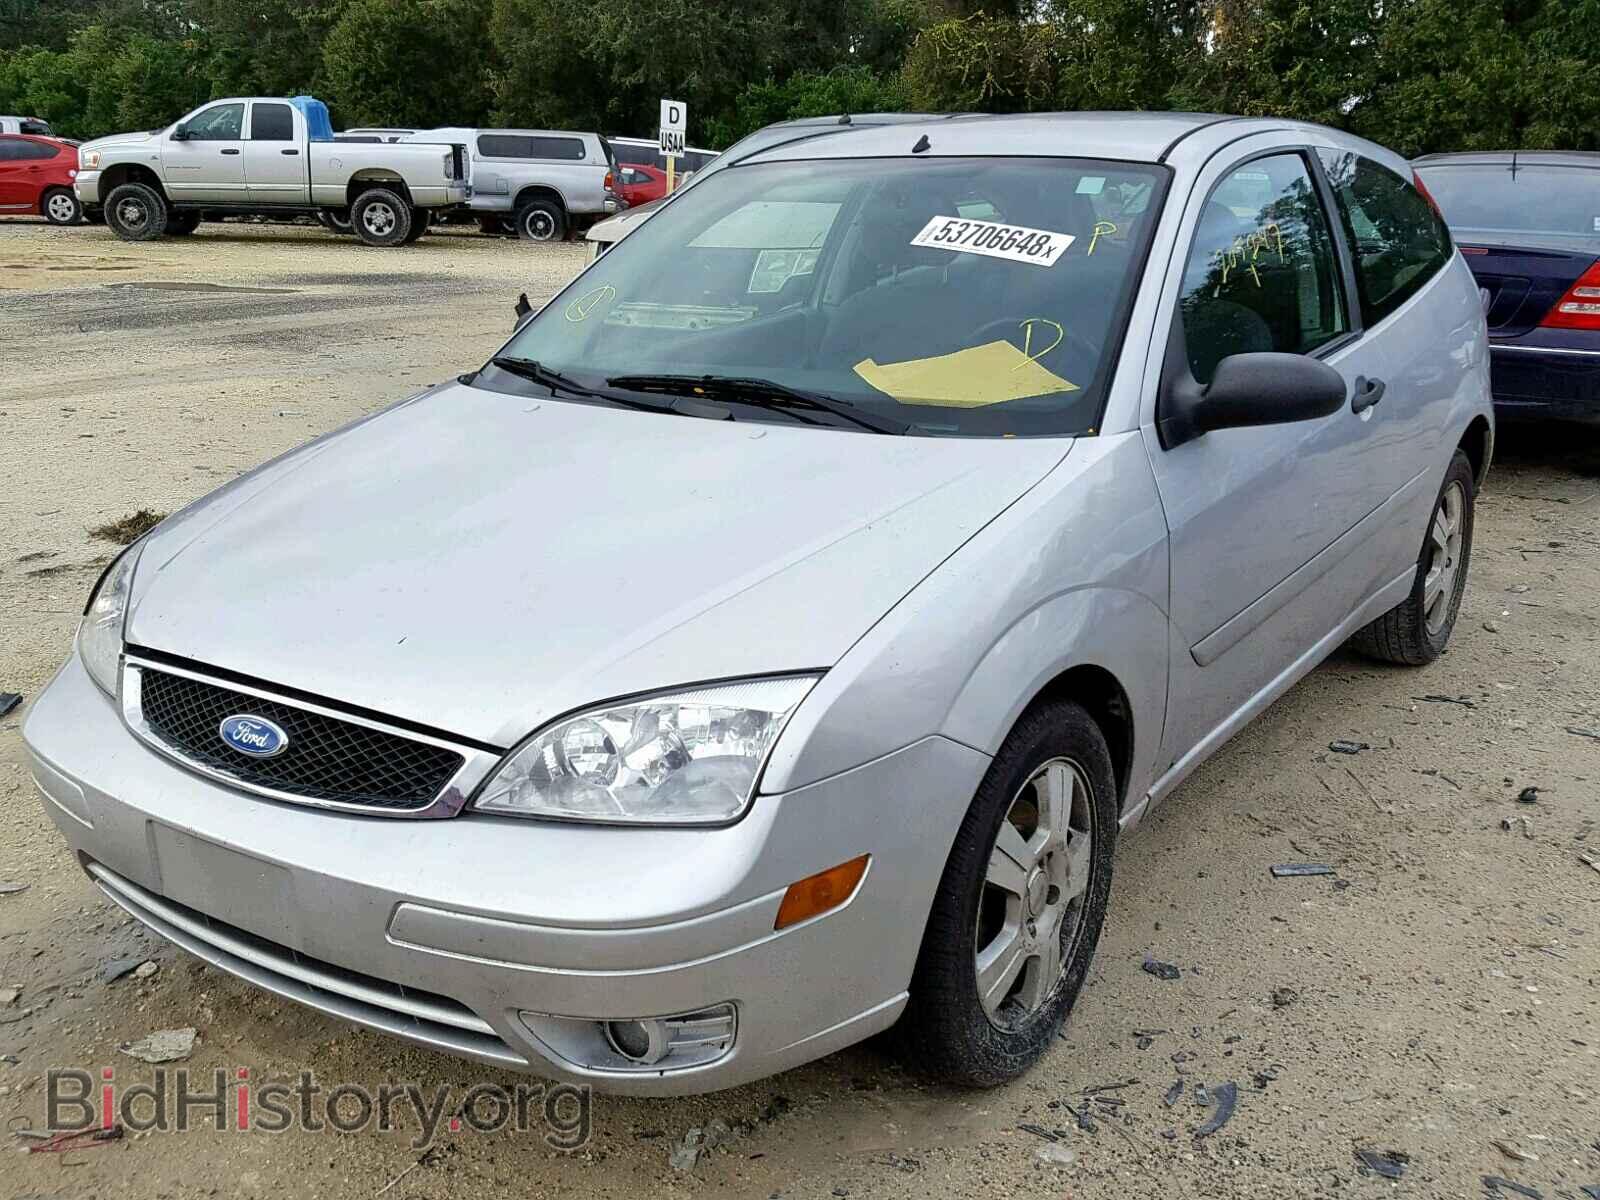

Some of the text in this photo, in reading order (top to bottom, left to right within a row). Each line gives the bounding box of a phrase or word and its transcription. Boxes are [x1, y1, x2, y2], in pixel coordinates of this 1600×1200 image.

[669, 106, 680, 124] D
[661, 131, 684, 153] USAA
[232, 720, 270, 747] Ford
